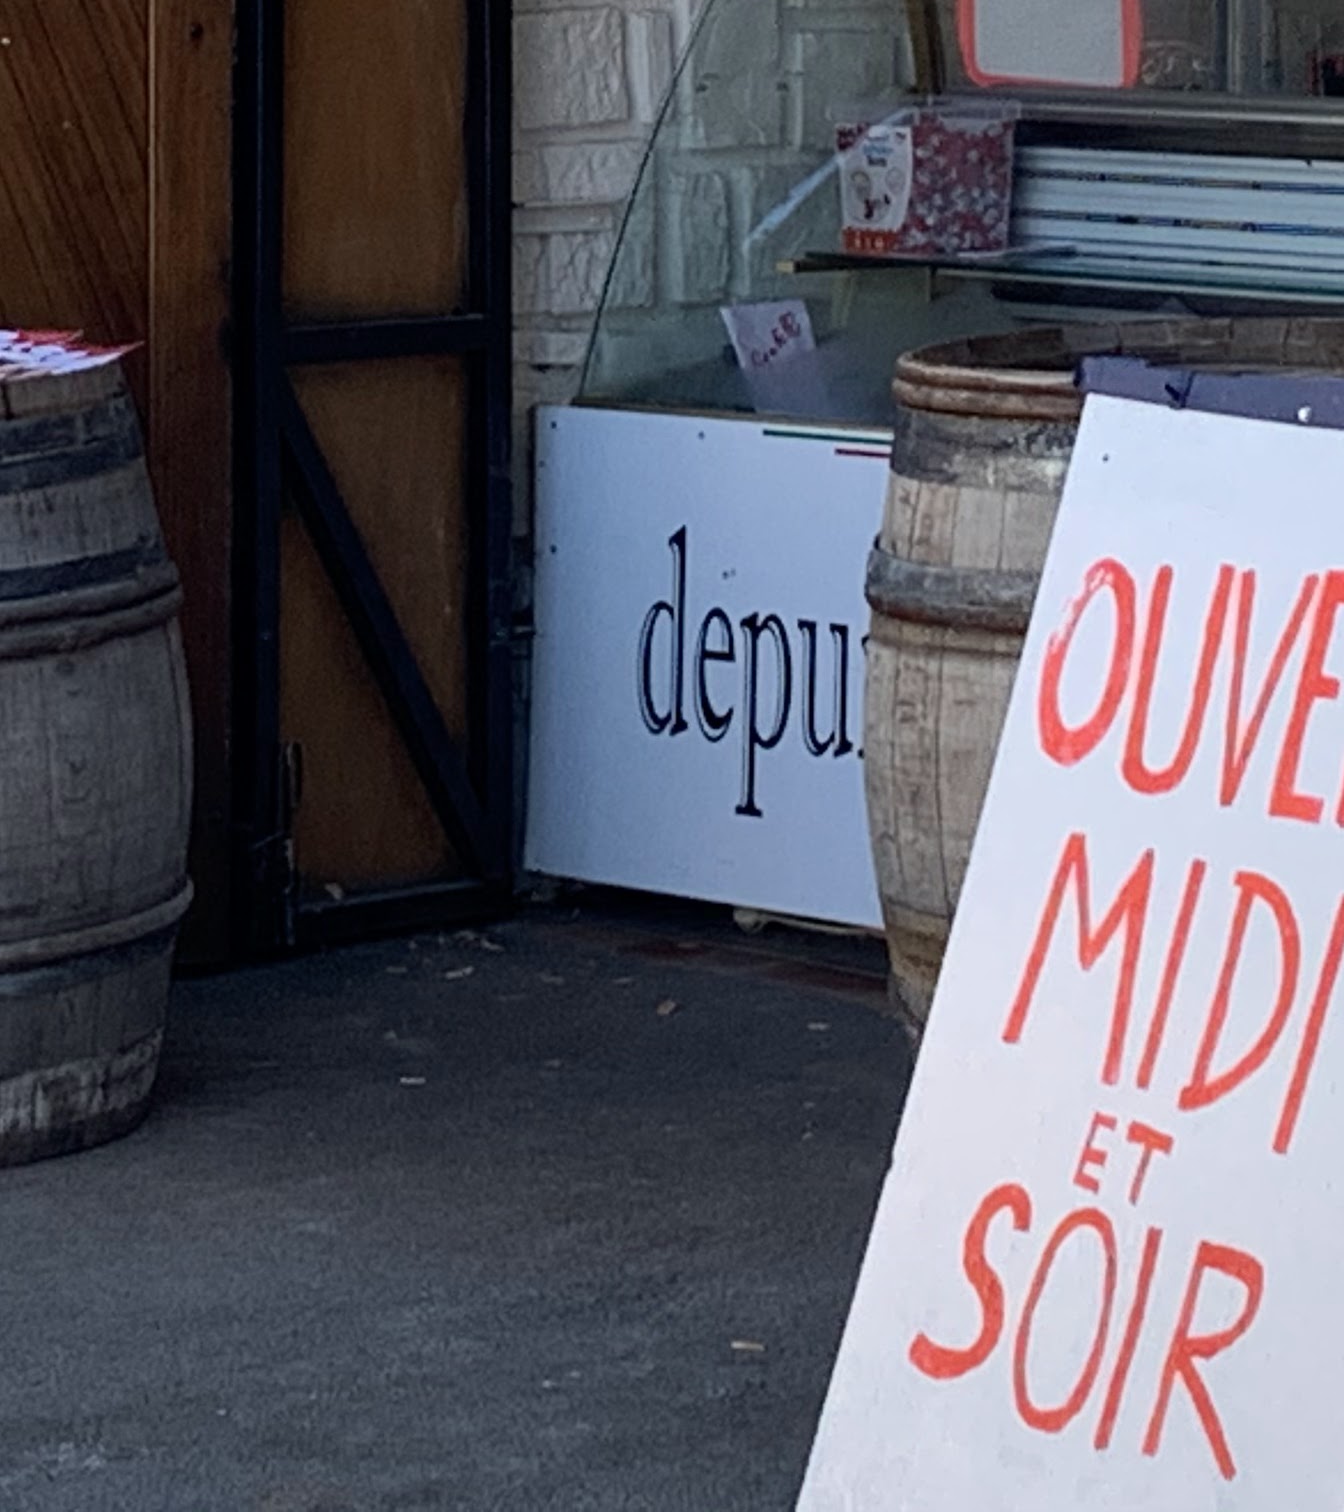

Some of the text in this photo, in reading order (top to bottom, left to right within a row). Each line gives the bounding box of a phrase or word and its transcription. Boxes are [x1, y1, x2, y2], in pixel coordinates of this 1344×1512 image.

[636, 525, 872, 818] depu
[1073, 1113, 1173, 1205] ET
[908, 1183, 1265, 1482] SOIR
